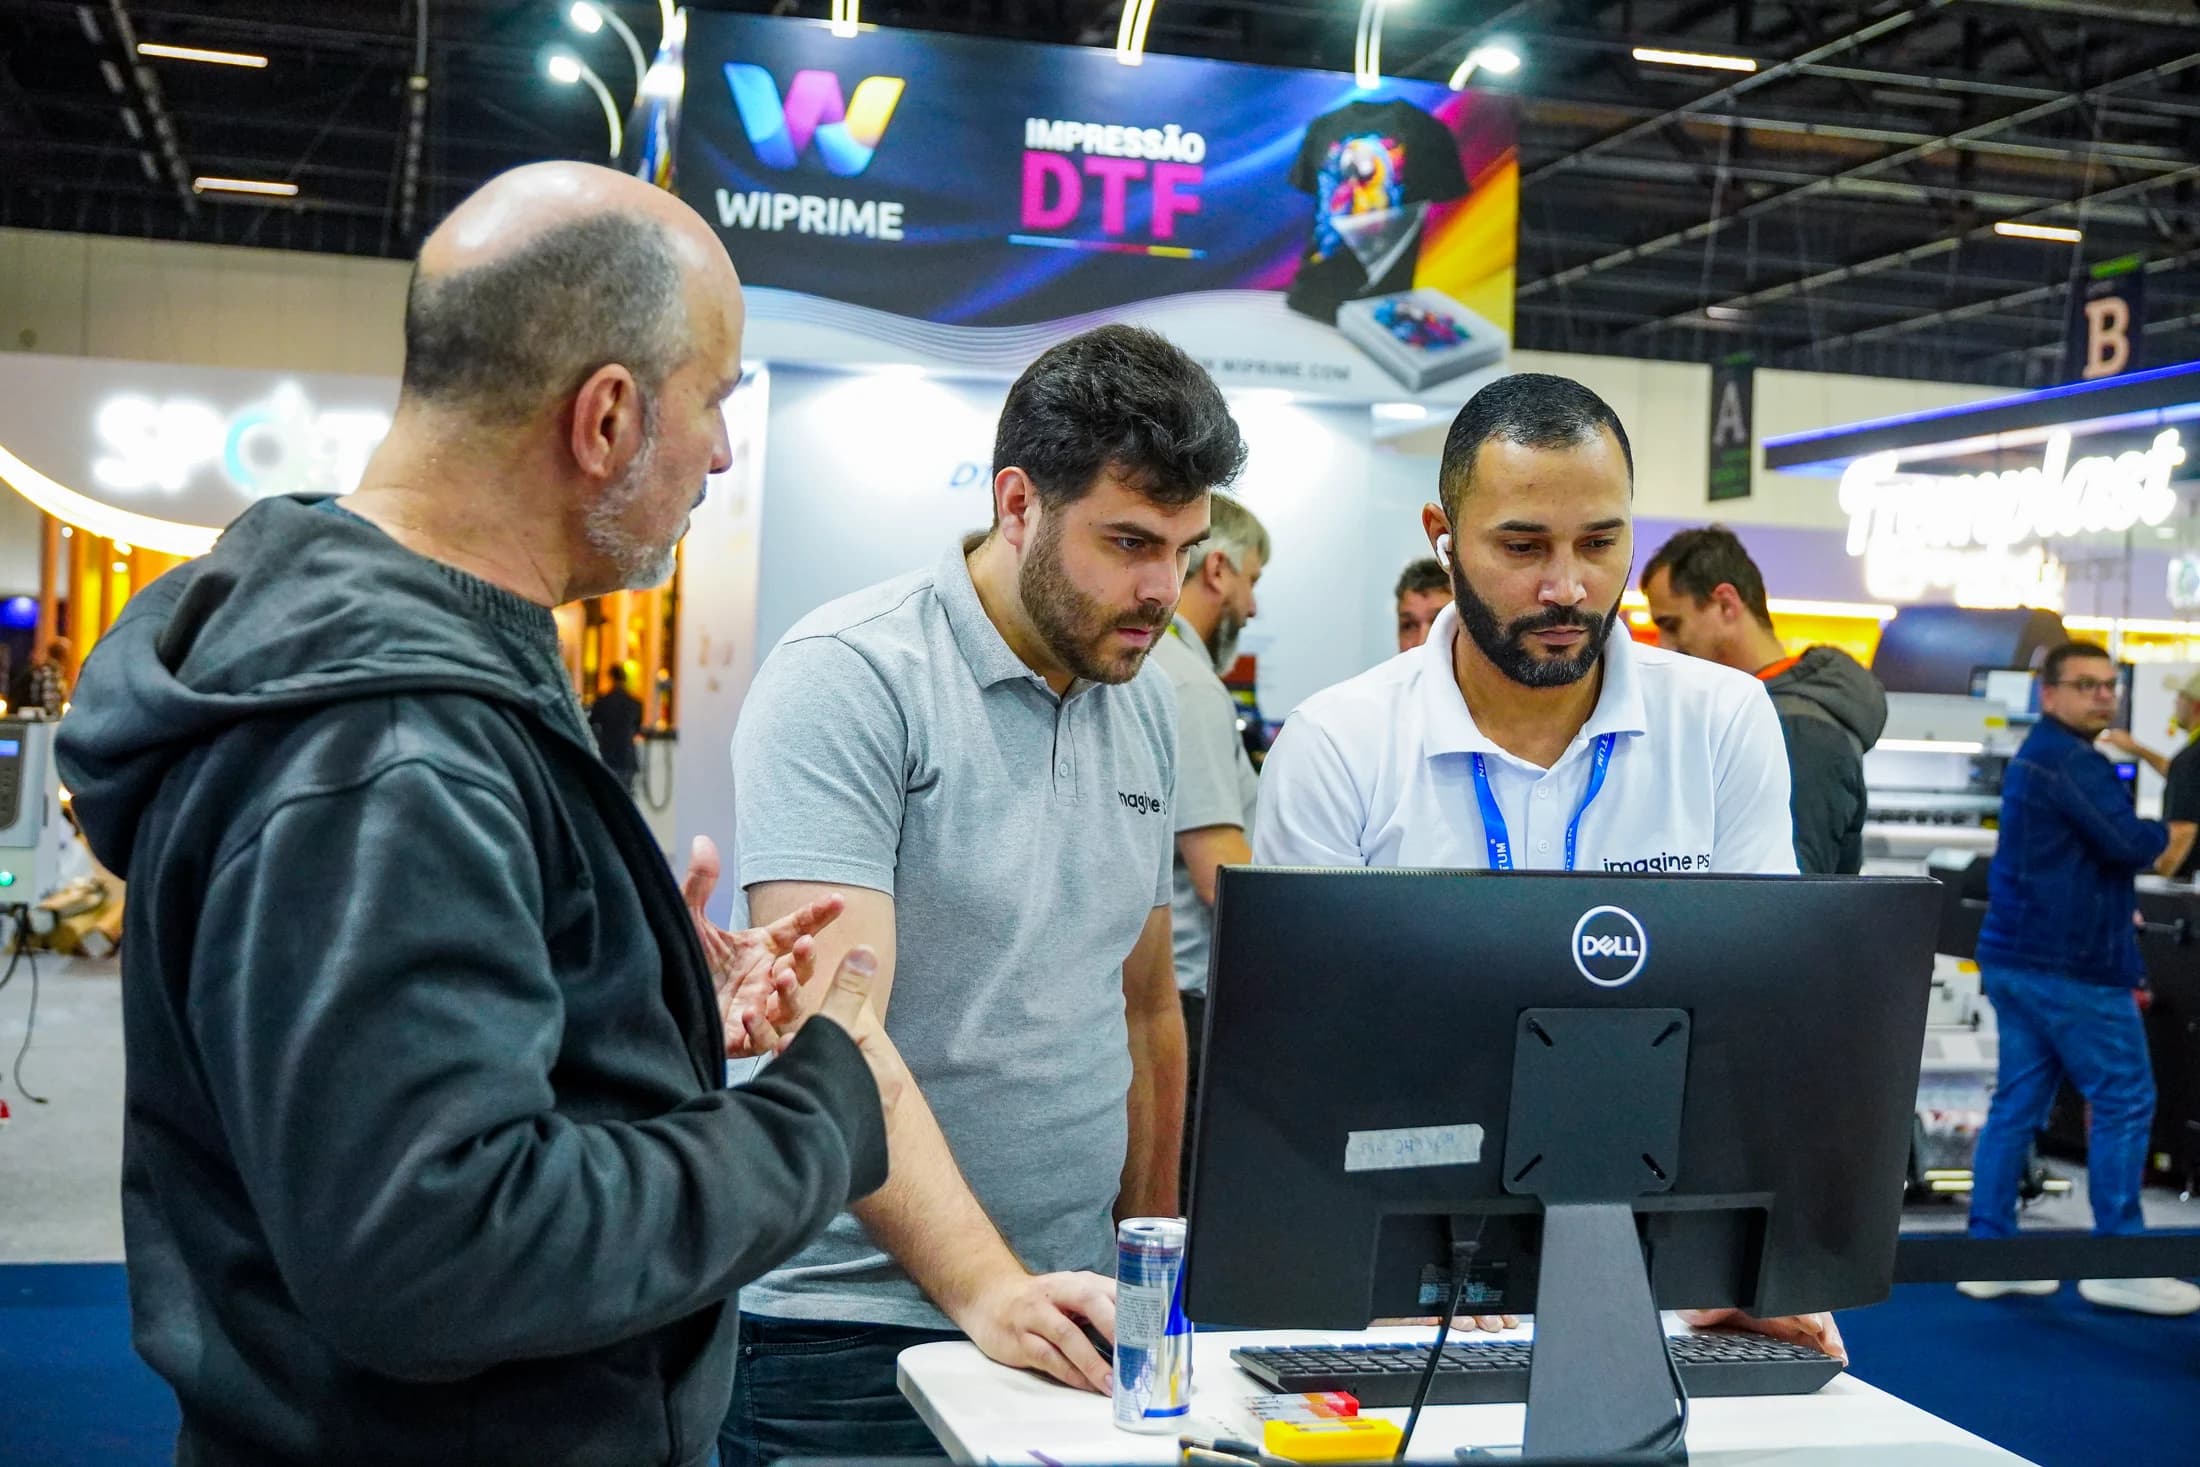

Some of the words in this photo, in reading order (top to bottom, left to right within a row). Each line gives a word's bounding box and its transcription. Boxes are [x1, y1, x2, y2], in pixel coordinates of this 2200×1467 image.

[1025, 117, 1205, 164] IMPRESSÃO
[716, 189, 904, 241] WIPRIME
[1020, 151, 1204, 239] DTF
[2083, 296, 2130, 379] B
[1713, 380, 1746, 447] A
[1582, 935, 1639, 957] DELL
